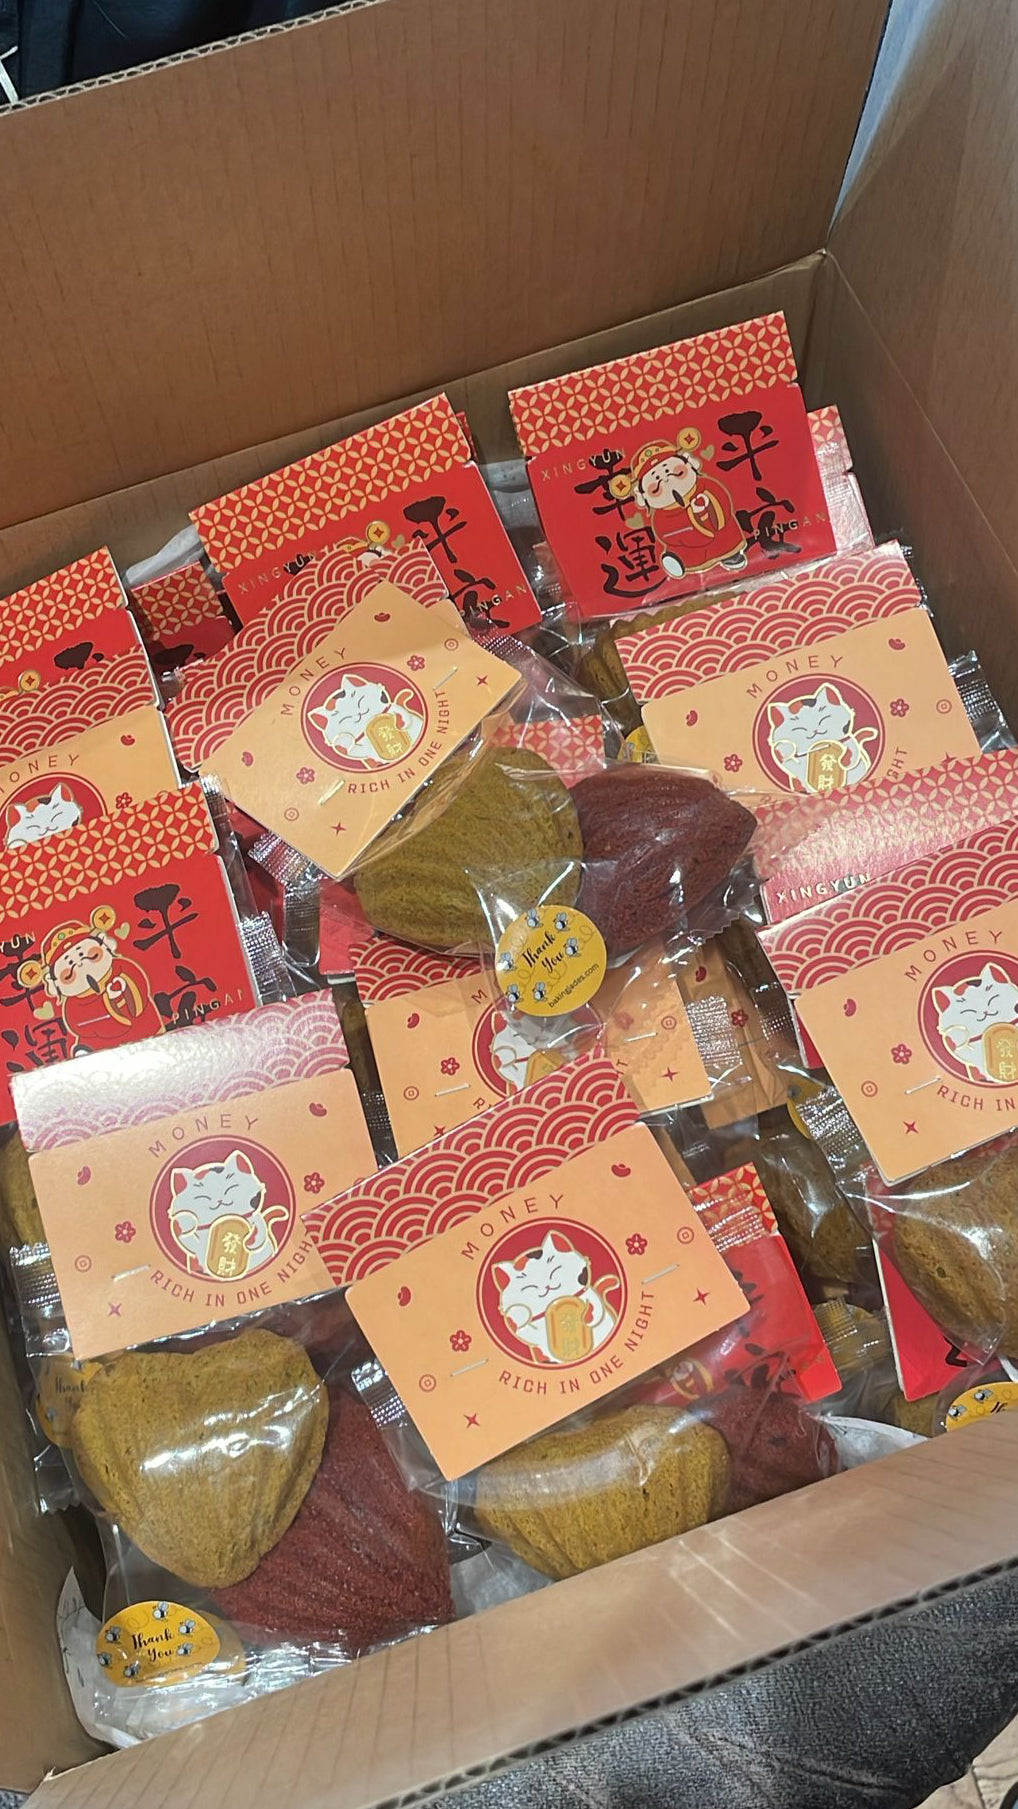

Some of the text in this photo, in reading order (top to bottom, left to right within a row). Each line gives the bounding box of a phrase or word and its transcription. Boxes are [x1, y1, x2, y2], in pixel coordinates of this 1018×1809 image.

[541, 449, 626, 482] XINGYUN
[752, 511, 827, 541] PINGAN
[281, 648, 346, 716] MONEY
[746, 655, 844, 699] MONEY
[348, 691, 451, 794] RICH IN ONE NIGHT
[0, 754, 80, 793] ONEY
[776, 873, 871, 904] XINGYUN
[522, 931, 557, 968] Thank
[541, 951, 564, 974] You
[904, 930, 1003, 982] MONEY
[548, 963, 600, 1008] bakingjades.com
[936, 1084, 1016, 1112] RICH IN
[148, 1114, 259, 1158] MONEY
[461, 1194, 564, 1260] MONEY
[150, 1240, 313, 1307] RICH IN ONE NIGH
[499, 1291, 655, 1395] RICH IN ONE NIGHT
[131, 1628, 174, 1650] Thank
[147, 1648, 173, 1662] You
